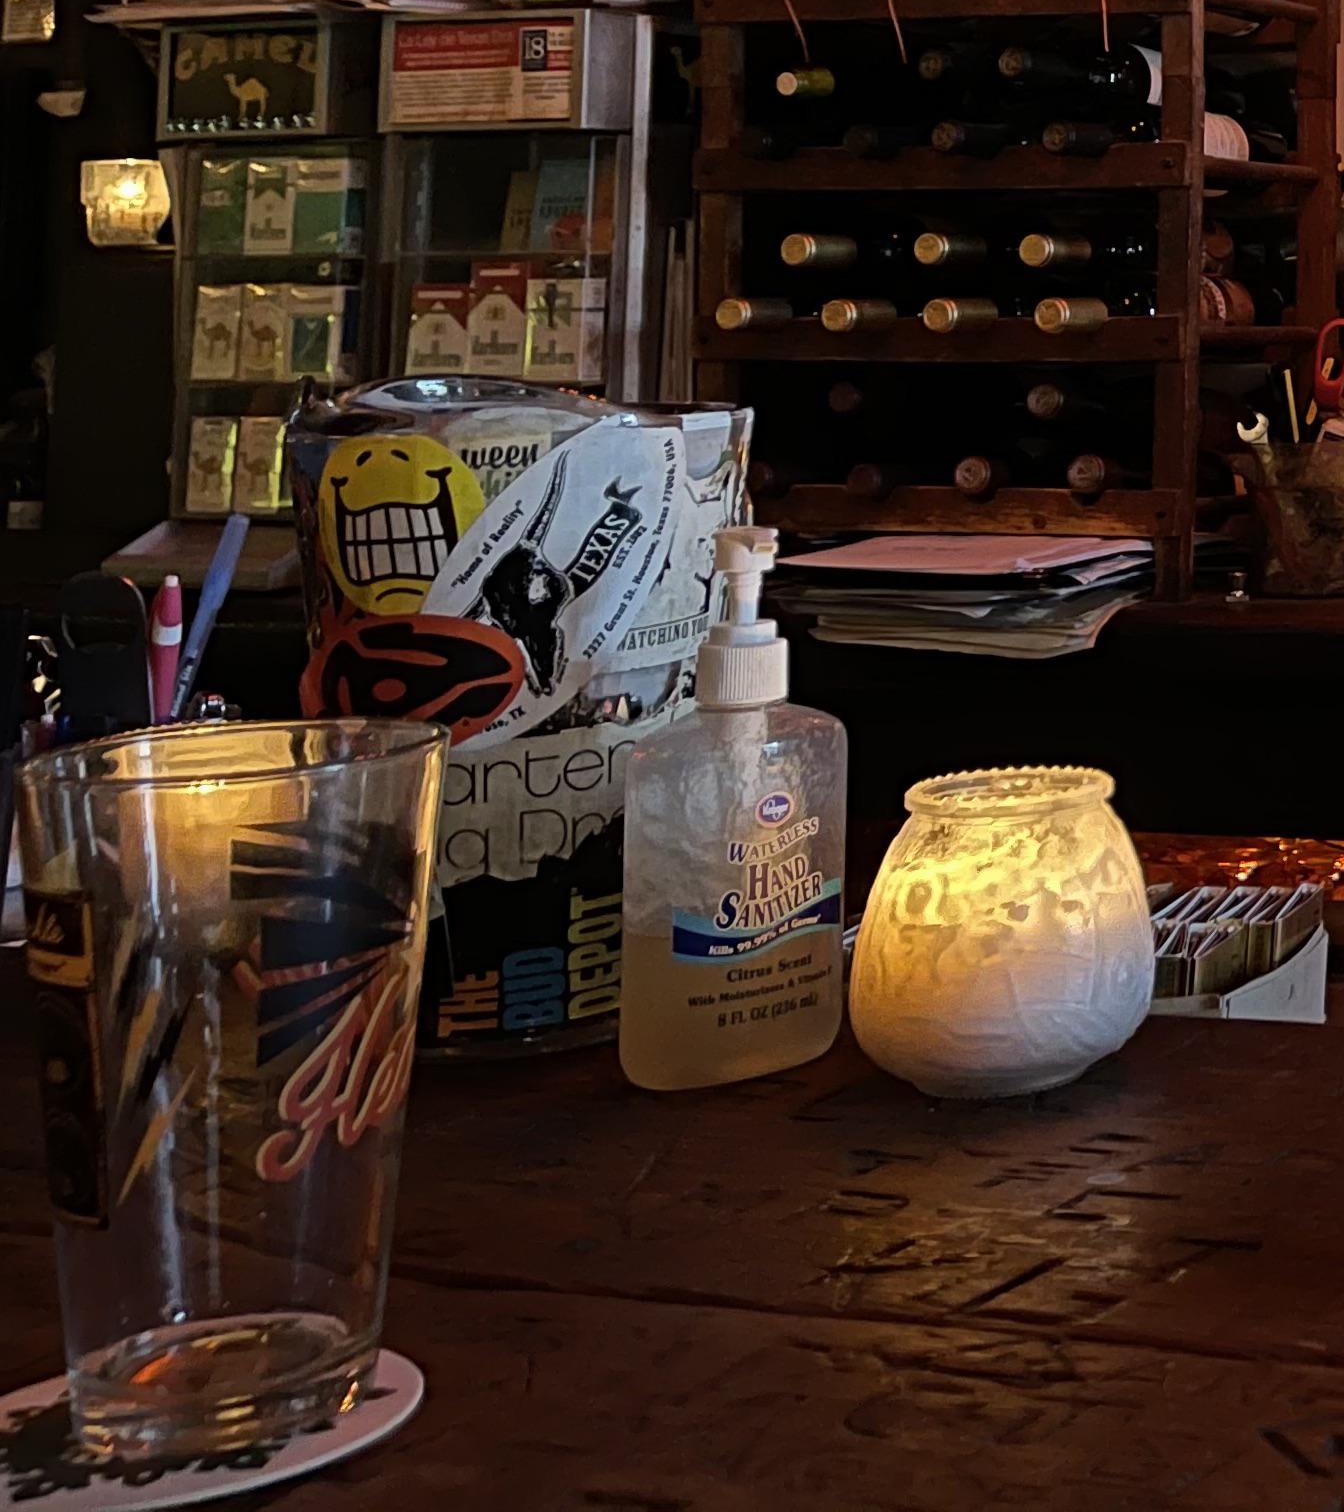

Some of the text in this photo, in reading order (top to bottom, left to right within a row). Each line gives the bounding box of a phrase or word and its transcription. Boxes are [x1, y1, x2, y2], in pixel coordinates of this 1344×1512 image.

[568, 512, 630, 586] TEXAS
[729, 817, 819, 863] WATERLESS
[716, 874, 822, 929] SANITIZER
[749, 856, 807, 901] HAND
[568, 888, 624, 1019] DEPOT
[727, 954, 812, 982] Citrus Scent
[438, 970, 499, 1038] THE
[503, 947, 565, 1030] BUD
